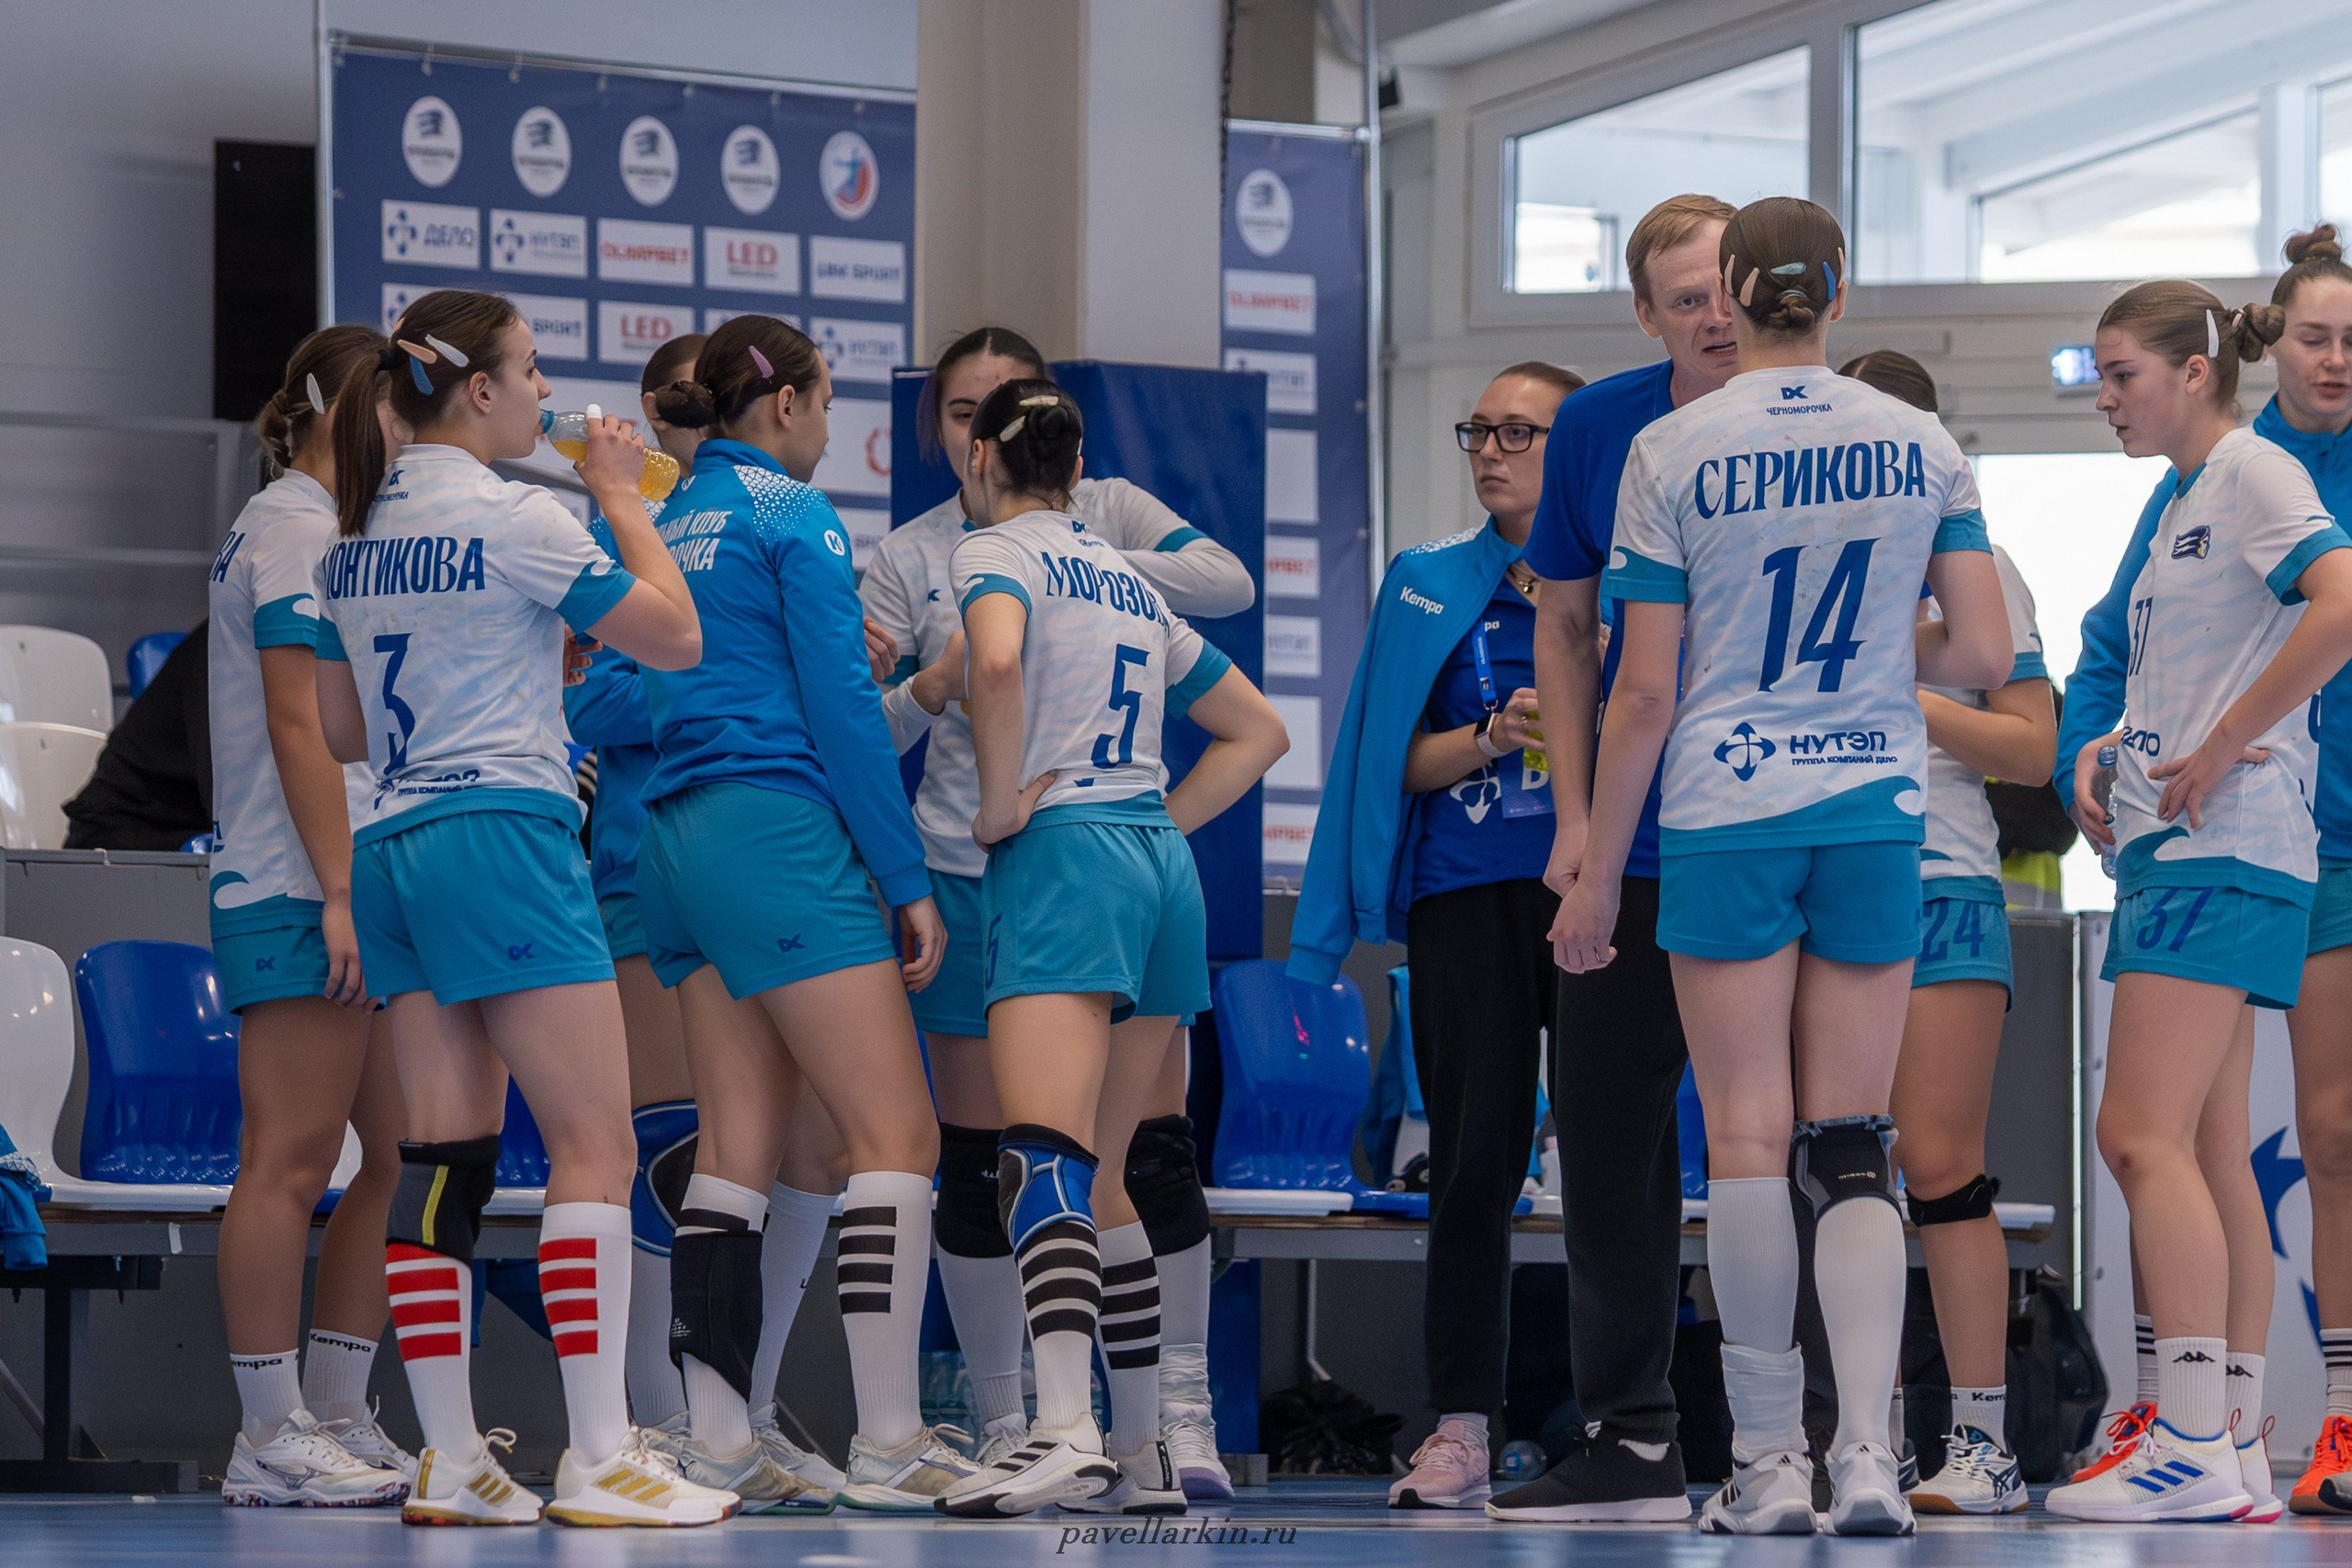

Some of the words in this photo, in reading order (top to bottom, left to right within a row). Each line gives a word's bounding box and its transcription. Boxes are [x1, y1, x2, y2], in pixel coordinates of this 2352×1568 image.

[727, 242, 778, 265] LED
[620, 314, 673, 339] LED
[1766, 403, 1833, 416] ЧЕРНОМОРОЧКА
[1694, 440, 1926, 520] СЕРИКОВА
[1399, 586, 1444, 615] Kempa
[1757, 537, 1882, 693] 14
[373, 632, 415, 776] 3
[1091, 643, 1151, 769] 5
[1790, 731, 1886, 754] НУТЭП
[1792, 758, 1826, 766] ГРУППА
[1826, 754, 1874, 764] КОМПАНИЙ
[1919, 897, 1985, 964] 24
[2136, 886, 2213, 953] 37
[311, 1333, 372, 1353] Kempa
